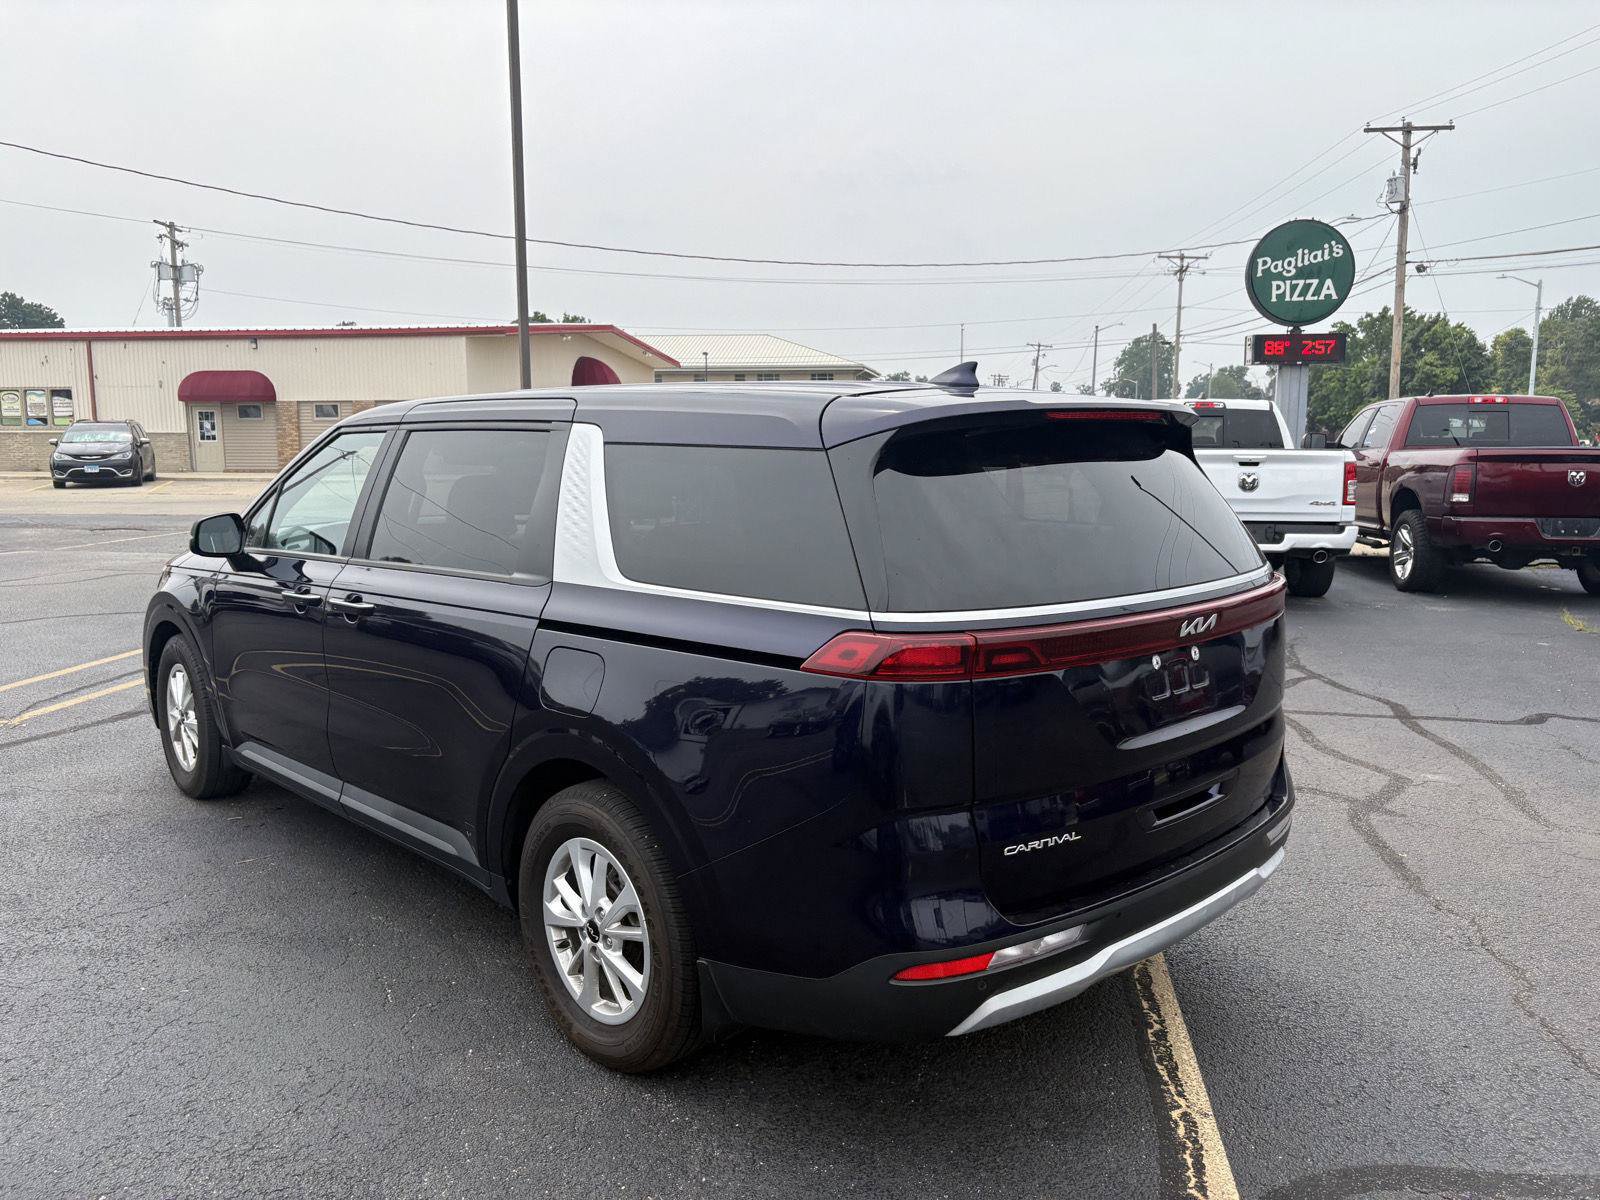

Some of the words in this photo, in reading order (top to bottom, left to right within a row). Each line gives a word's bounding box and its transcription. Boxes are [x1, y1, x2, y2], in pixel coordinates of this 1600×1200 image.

[1256, 241, 1344, 277] Pagliai's
[1270, 278, 1338, 302] PIZZA
[1302, 339, 1336, 355] 2:57
[1003, 831, 1082, 856] CARNIVAL
